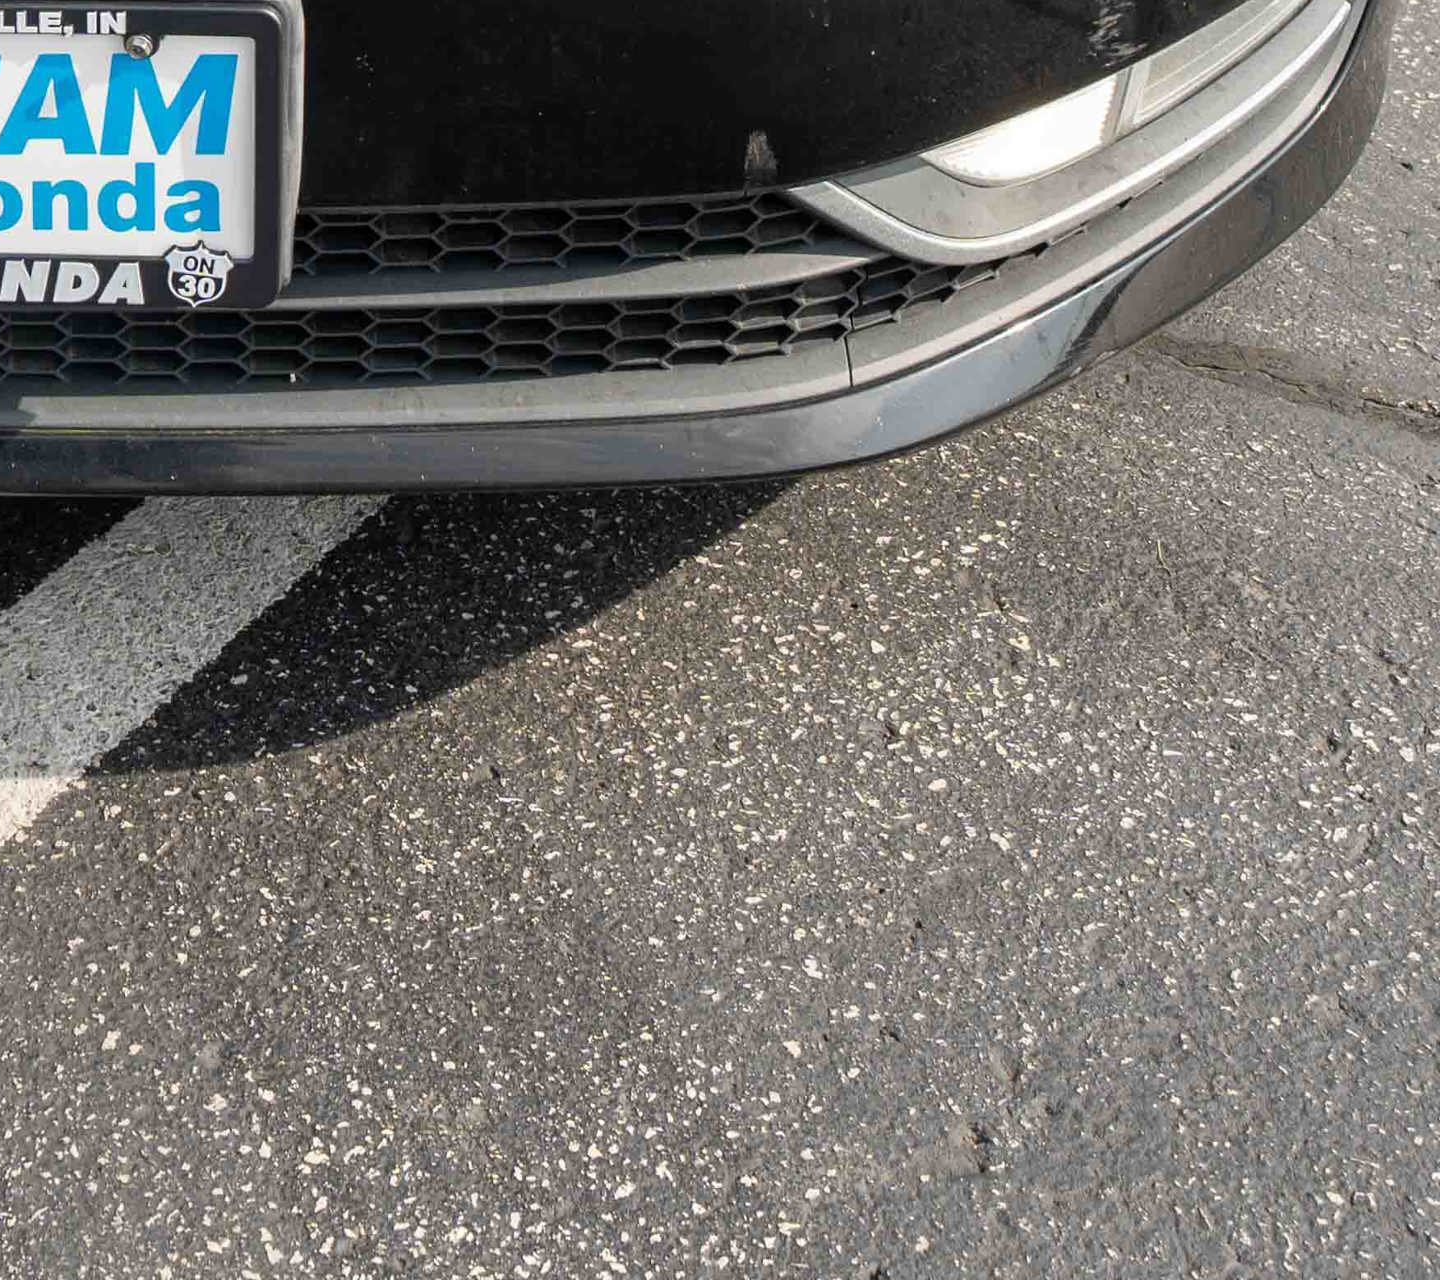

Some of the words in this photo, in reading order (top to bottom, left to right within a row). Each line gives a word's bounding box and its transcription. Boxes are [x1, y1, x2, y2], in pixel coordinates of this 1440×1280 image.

[86, 10, 127, 35] IN
[183, 255, 216, 275] ON
[177, 274, 216, 299] 30
